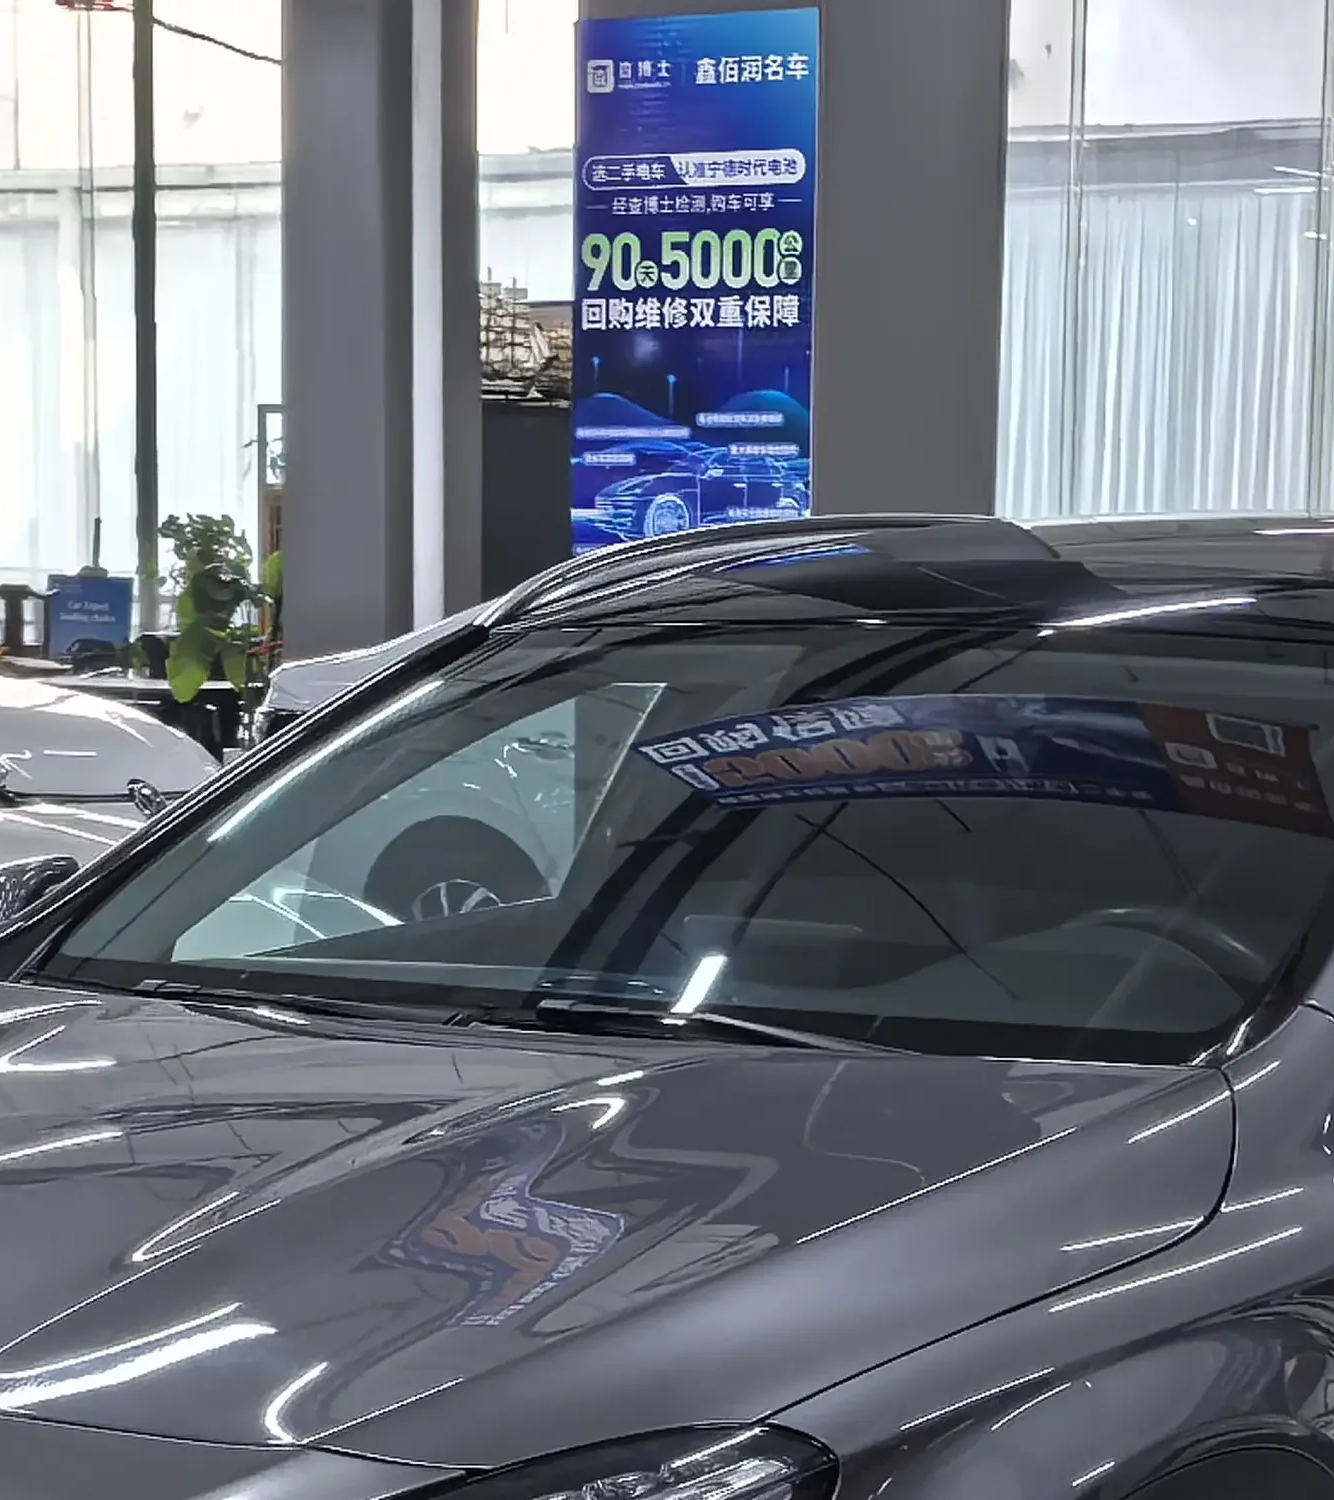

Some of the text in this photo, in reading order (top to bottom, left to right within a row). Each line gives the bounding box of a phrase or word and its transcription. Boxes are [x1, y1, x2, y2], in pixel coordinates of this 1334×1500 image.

[695, 53, 809, 85] 鑫佰润名车
[582, 294, 799, 330] 回购维修双重保障
